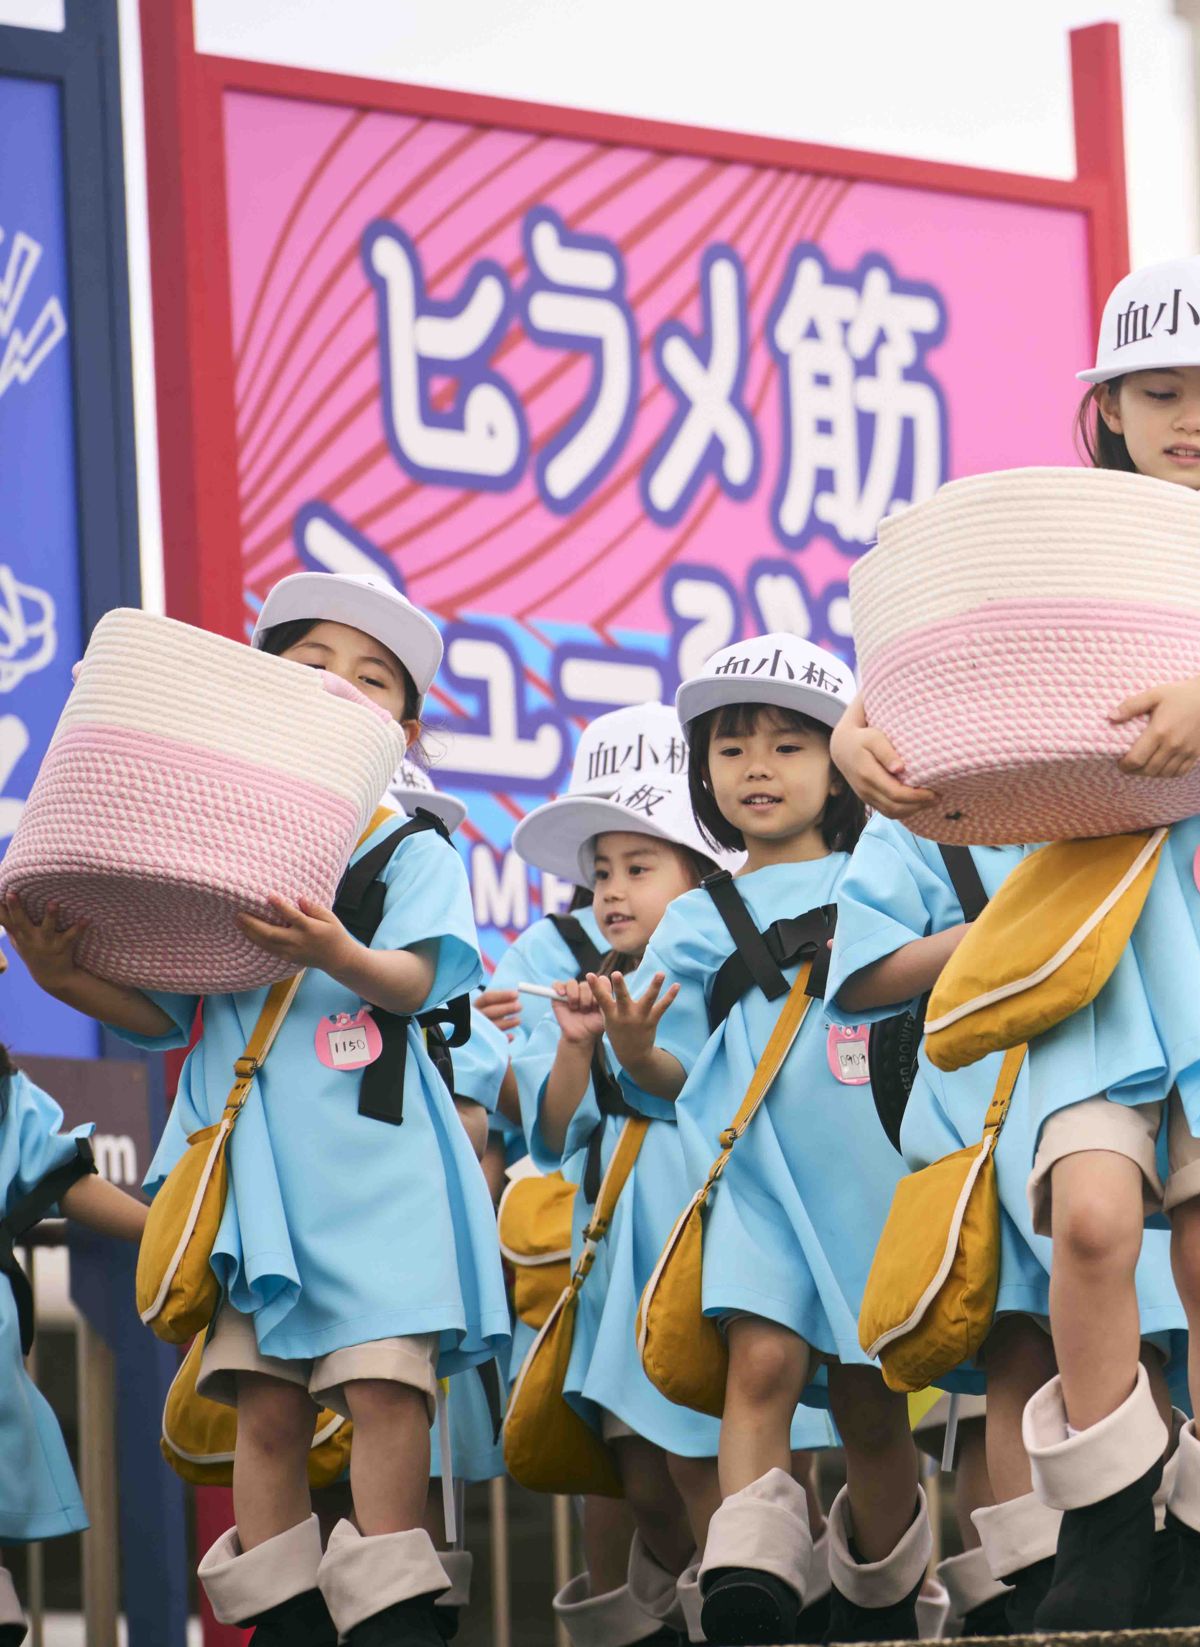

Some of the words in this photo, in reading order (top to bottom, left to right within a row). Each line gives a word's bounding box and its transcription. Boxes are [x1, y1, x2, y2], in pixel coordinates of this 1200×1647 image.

[366, 216, 944, 544] ヒラメ筋
[333, 1039, 367, 1055] 1150
